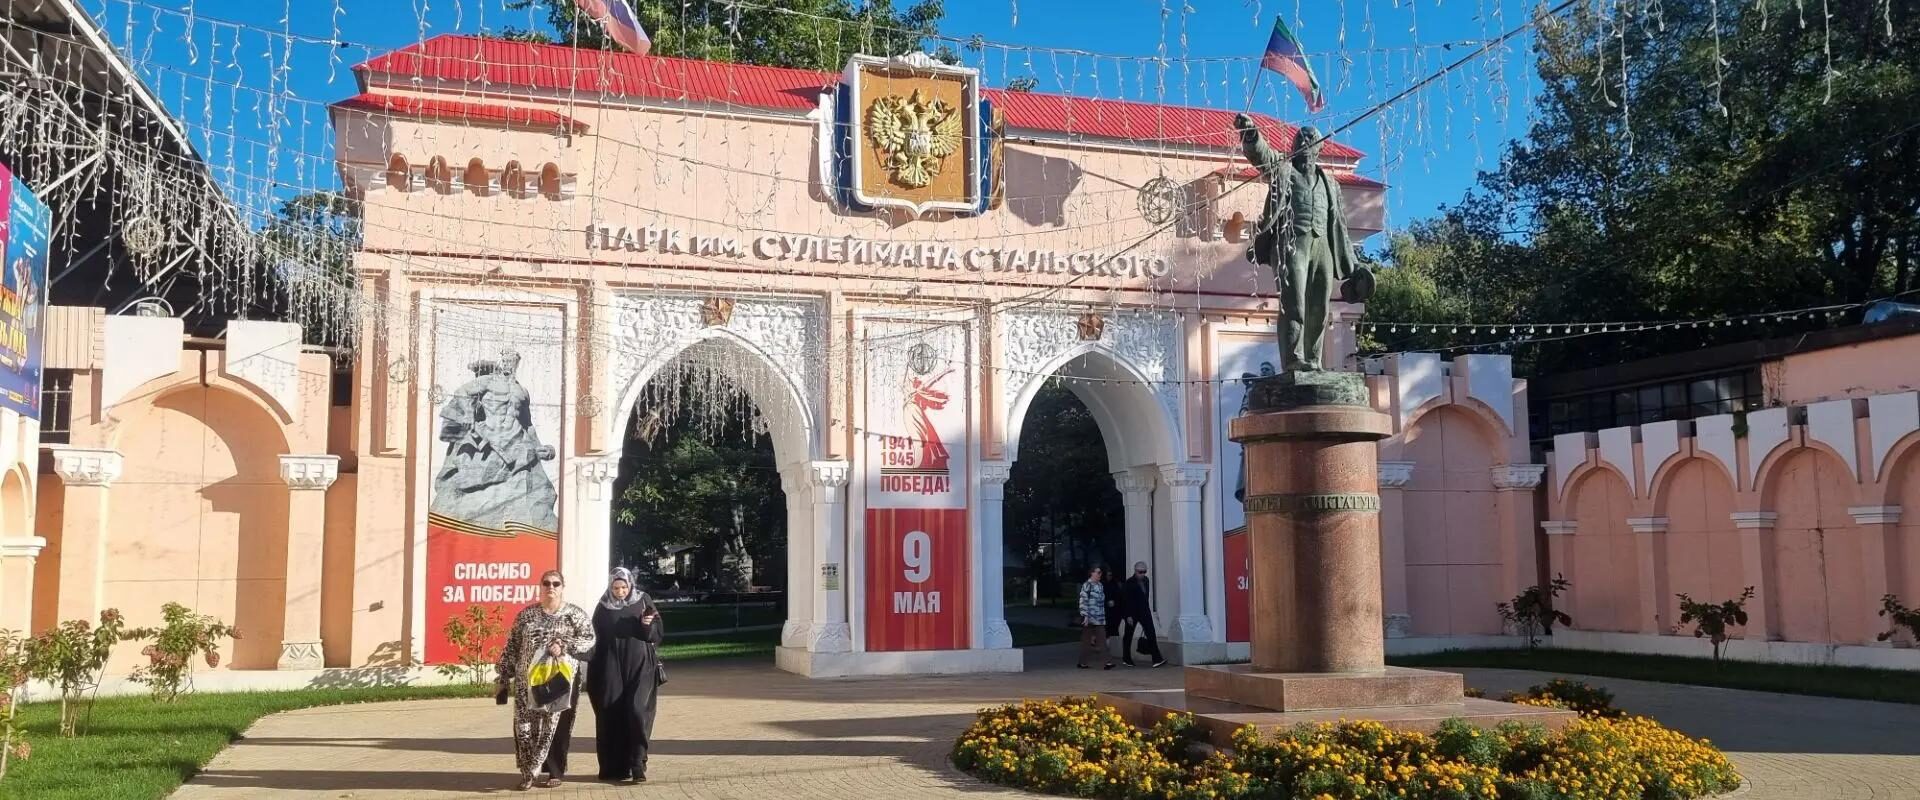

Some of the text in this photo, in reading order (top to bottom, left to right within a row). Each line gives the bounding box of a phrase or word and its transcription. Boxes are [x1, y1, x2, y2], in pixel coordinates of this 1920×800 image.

[587, 223, 683, 254] ПАРК
[754, 234, 960, 270] СУЛЕЙМАНА
[965, 247, 1170, 278] СТАЛЬСКОГО
[881, 434, 914, 450] 1941
[881, 452, 914, 466] 1945
[880, 475, 950, 495] ПОБЕДА!
[903, 531, 931, 583] 9
[454, 562, 531, 580] СПАСИБО
[443, 584, 541, 604] ЗА ПОБЕДУ!
[893, 591, 941, 614] МАЯ
